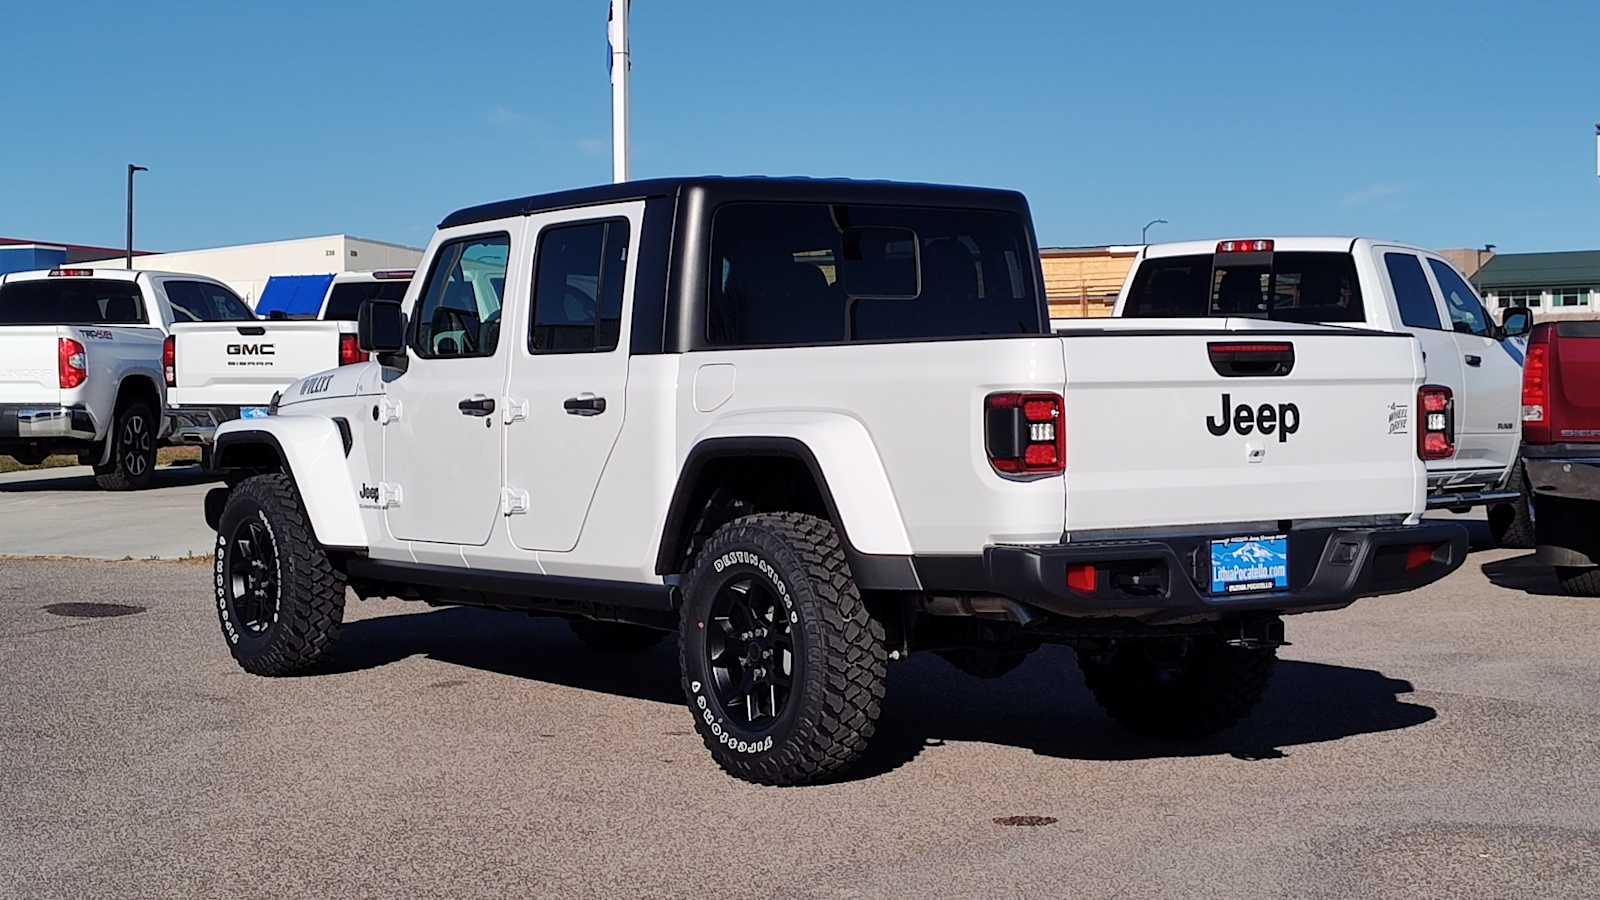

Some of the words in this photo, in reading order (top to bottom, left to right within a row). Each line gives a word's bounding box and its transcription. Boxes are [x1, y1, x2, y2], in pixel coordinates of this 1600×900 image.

[226, 344, 276, 355] GMC
[1206, 393, 1300, 443] Jeep
[359, 482, 380, 503] Jeep
[713, 551, 794, 609] DESTINATION
